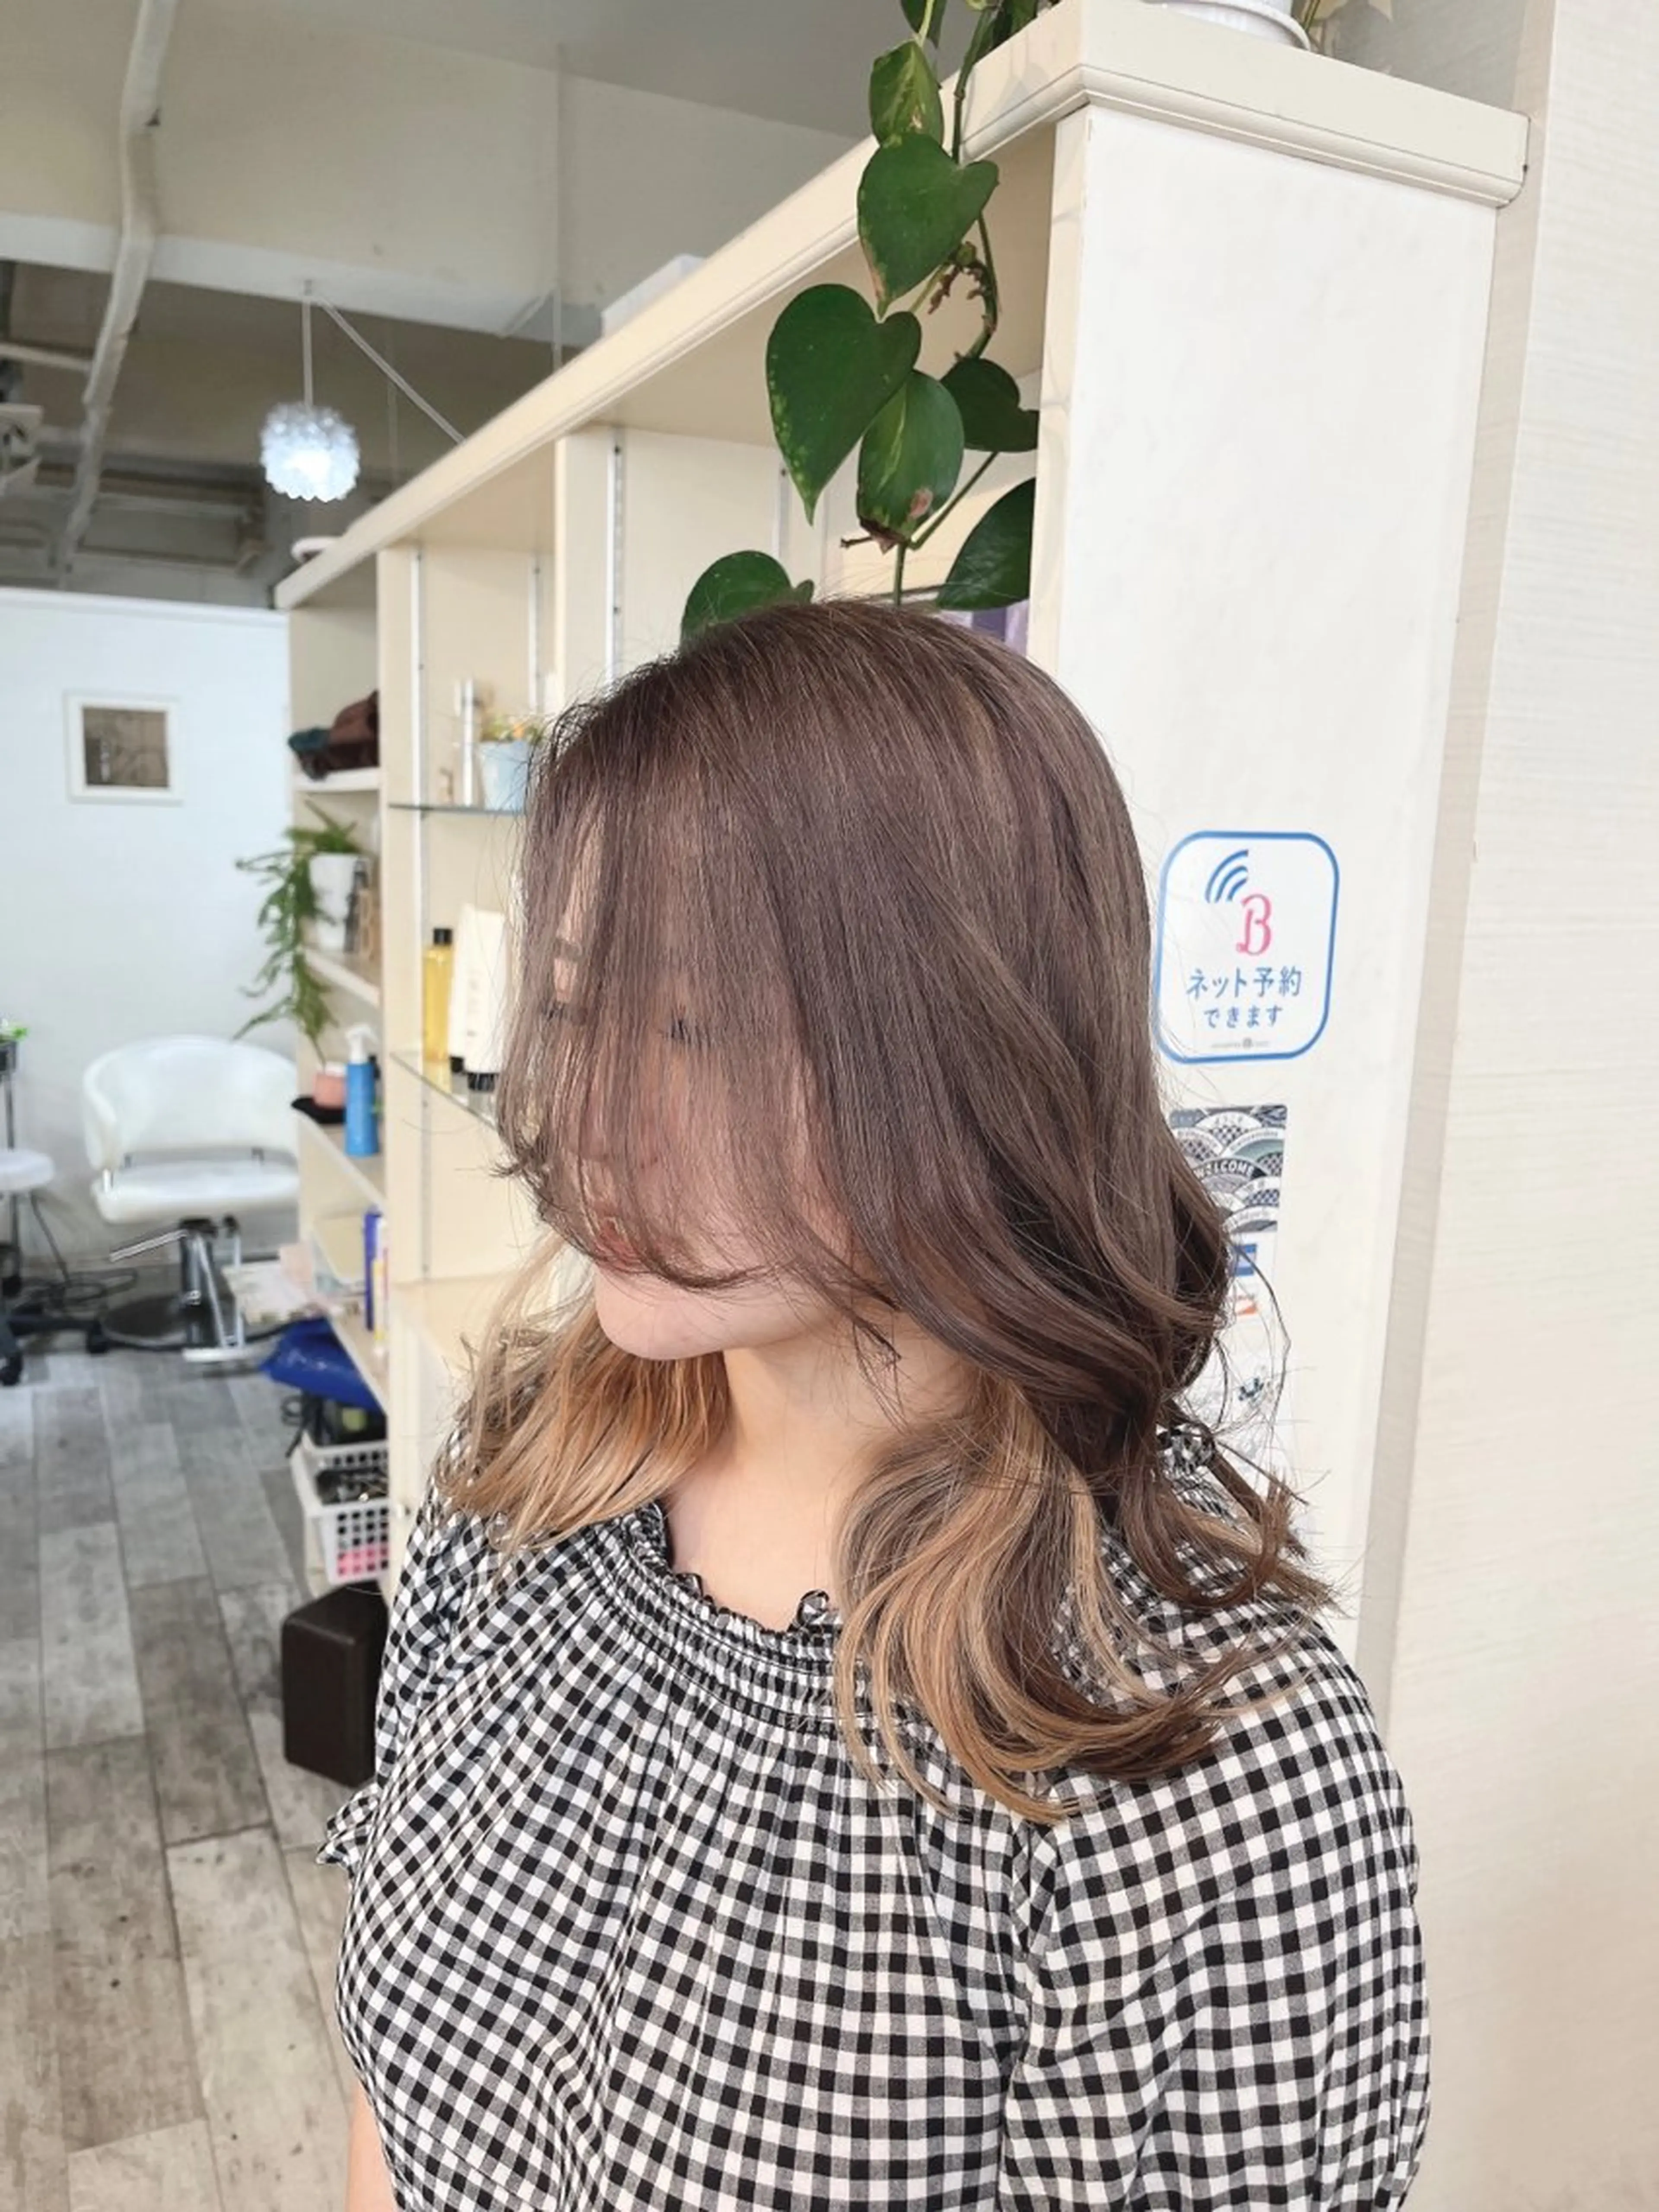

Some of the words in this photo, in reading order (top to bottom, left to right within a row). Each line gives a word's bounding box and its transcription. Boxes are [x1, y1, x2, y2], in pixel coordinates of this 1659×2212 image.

[1236, 894, 1271, 955] B
[1186, 966, 1301, 1000] ネット予約
[1204, 1005, 1282, 1028] できます
